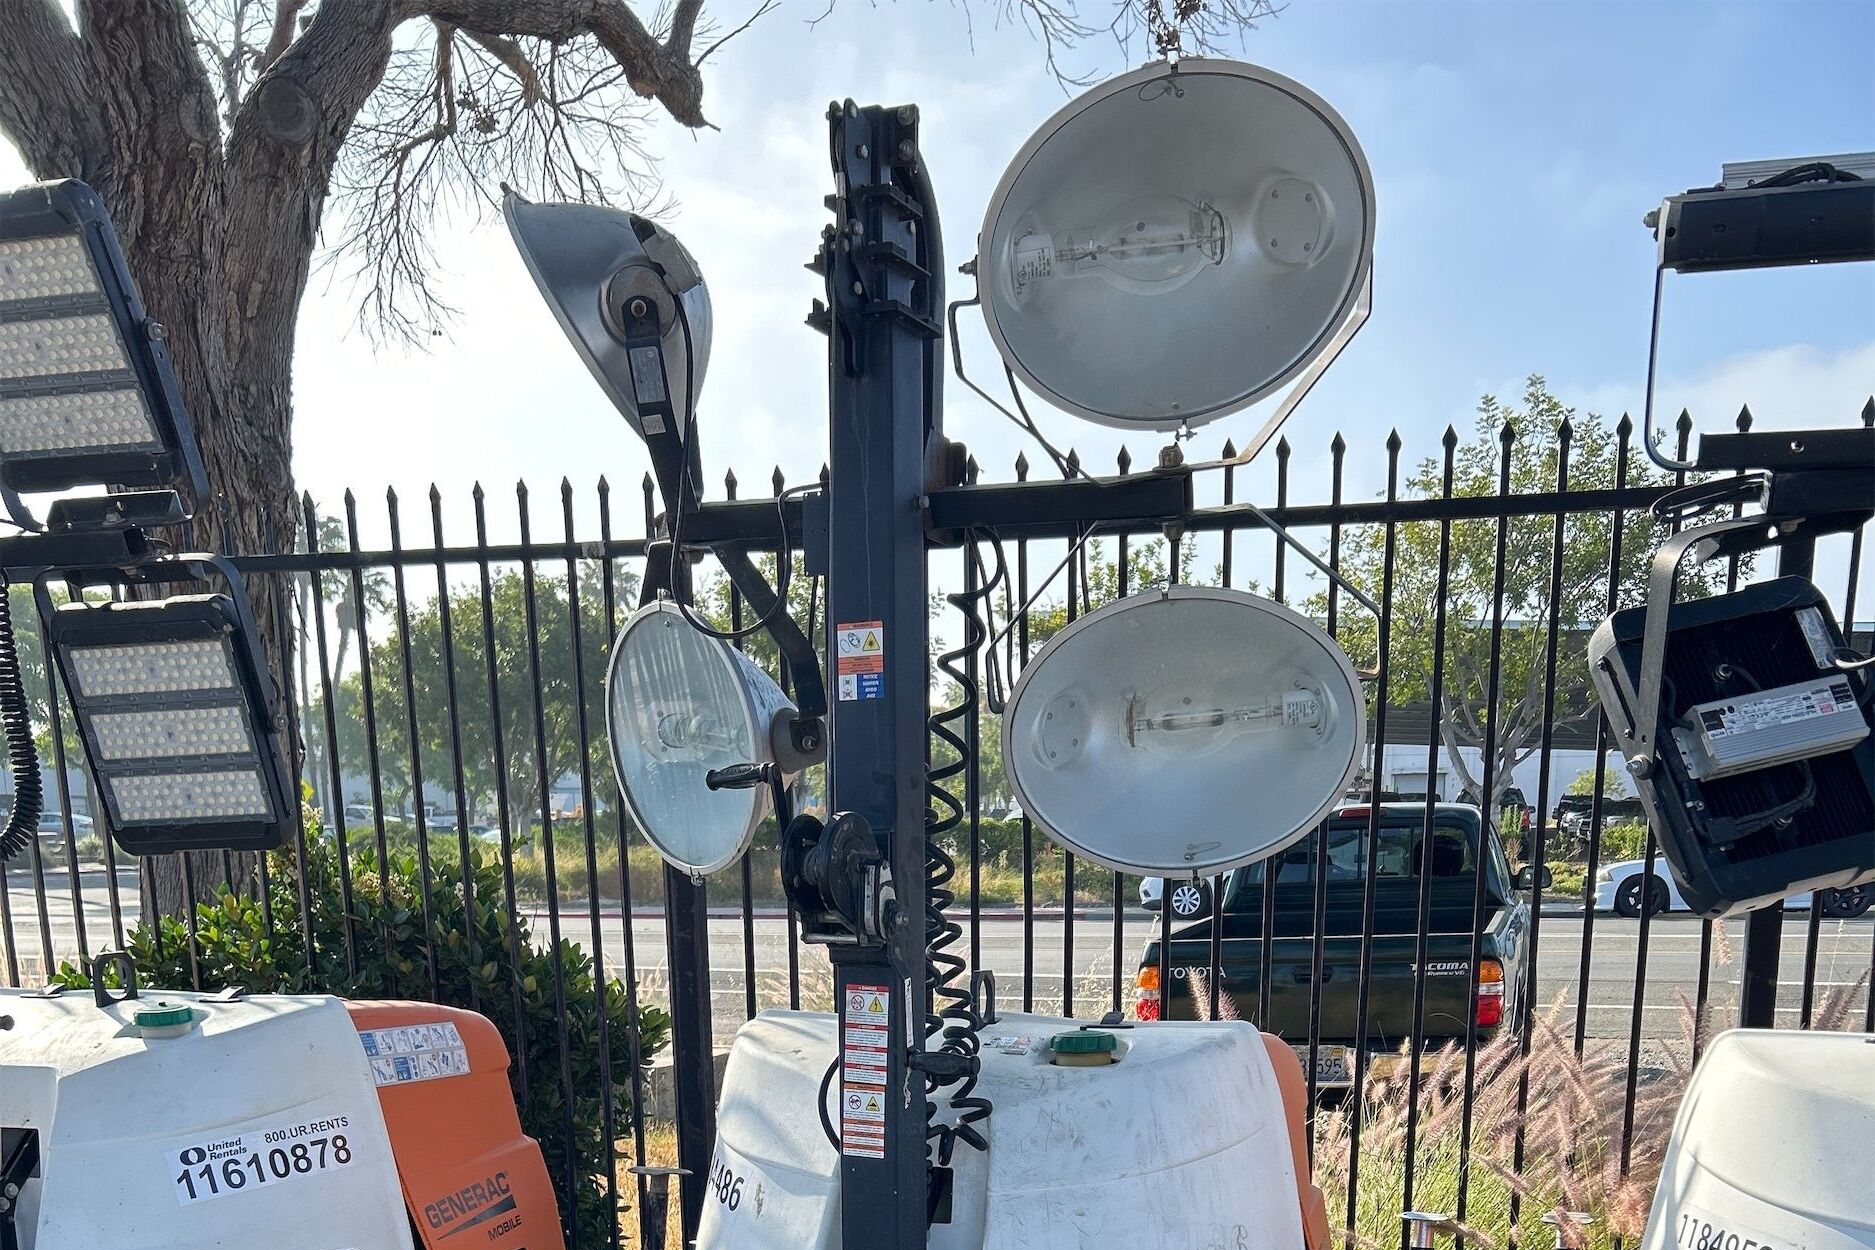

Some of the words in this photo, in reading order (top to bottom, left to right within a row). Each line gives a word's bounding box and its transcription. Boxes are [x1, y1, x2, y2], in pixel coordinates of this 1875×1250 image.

[1410, 962, 1469, 971] TCOMA
[264, 1116, 349, 1143] 800.UR.RENTS
[207, 1137, 242, 1152] United
[209, 1146, 247, 1161] Rentals
[177, 1134, 352, 1200] 11610878
[424, 1171, 510, 1229] GENERAC
[487, 1214, 522, 1241] MOBILE
